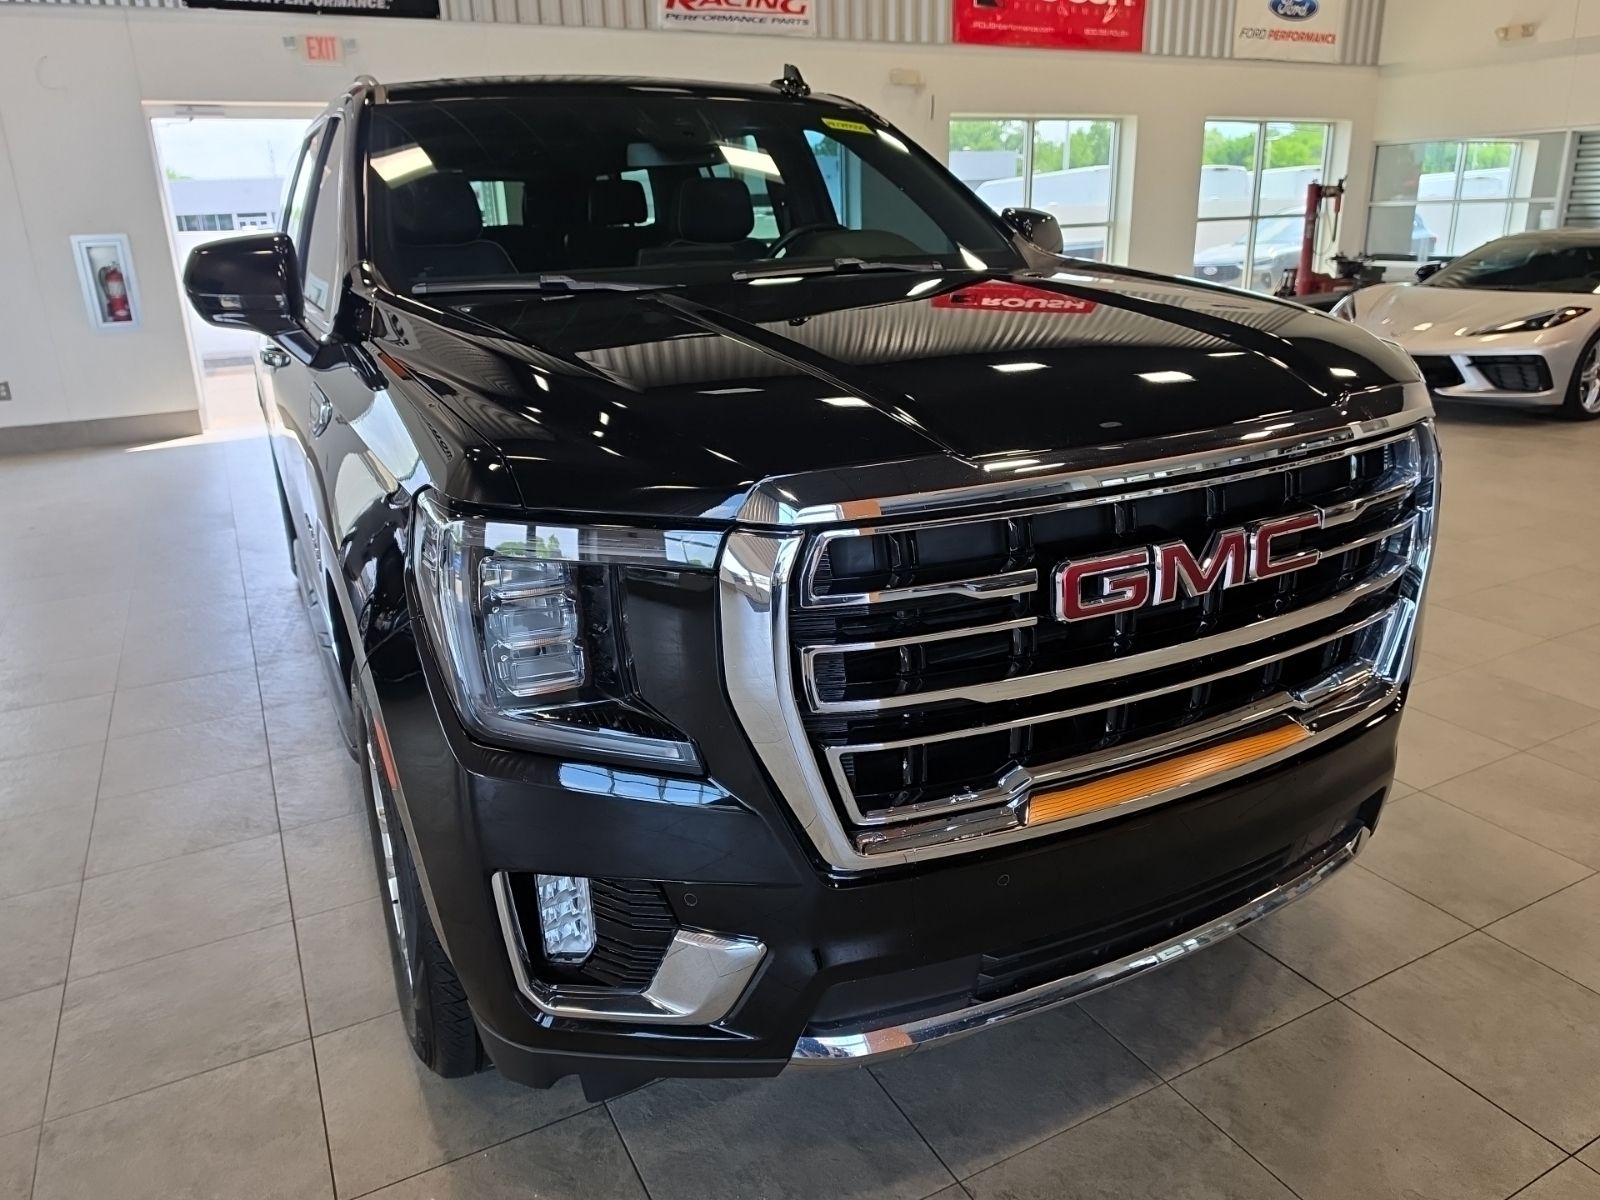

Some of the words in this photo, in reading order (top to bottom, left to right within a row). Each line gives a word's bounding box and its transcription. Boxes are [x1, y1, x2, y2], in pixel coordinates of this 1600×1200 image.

[665, 13, 767, 24] PERFORMANCE
[771, 18, 809, 26] PARTS
[1239, 27, 1267, 40] FORD
[1268, 29, 1336, 45] PERFORMANCE
[305, 36, 337, 60] EXIT
[1053, 509, 1322, 623] GMC
